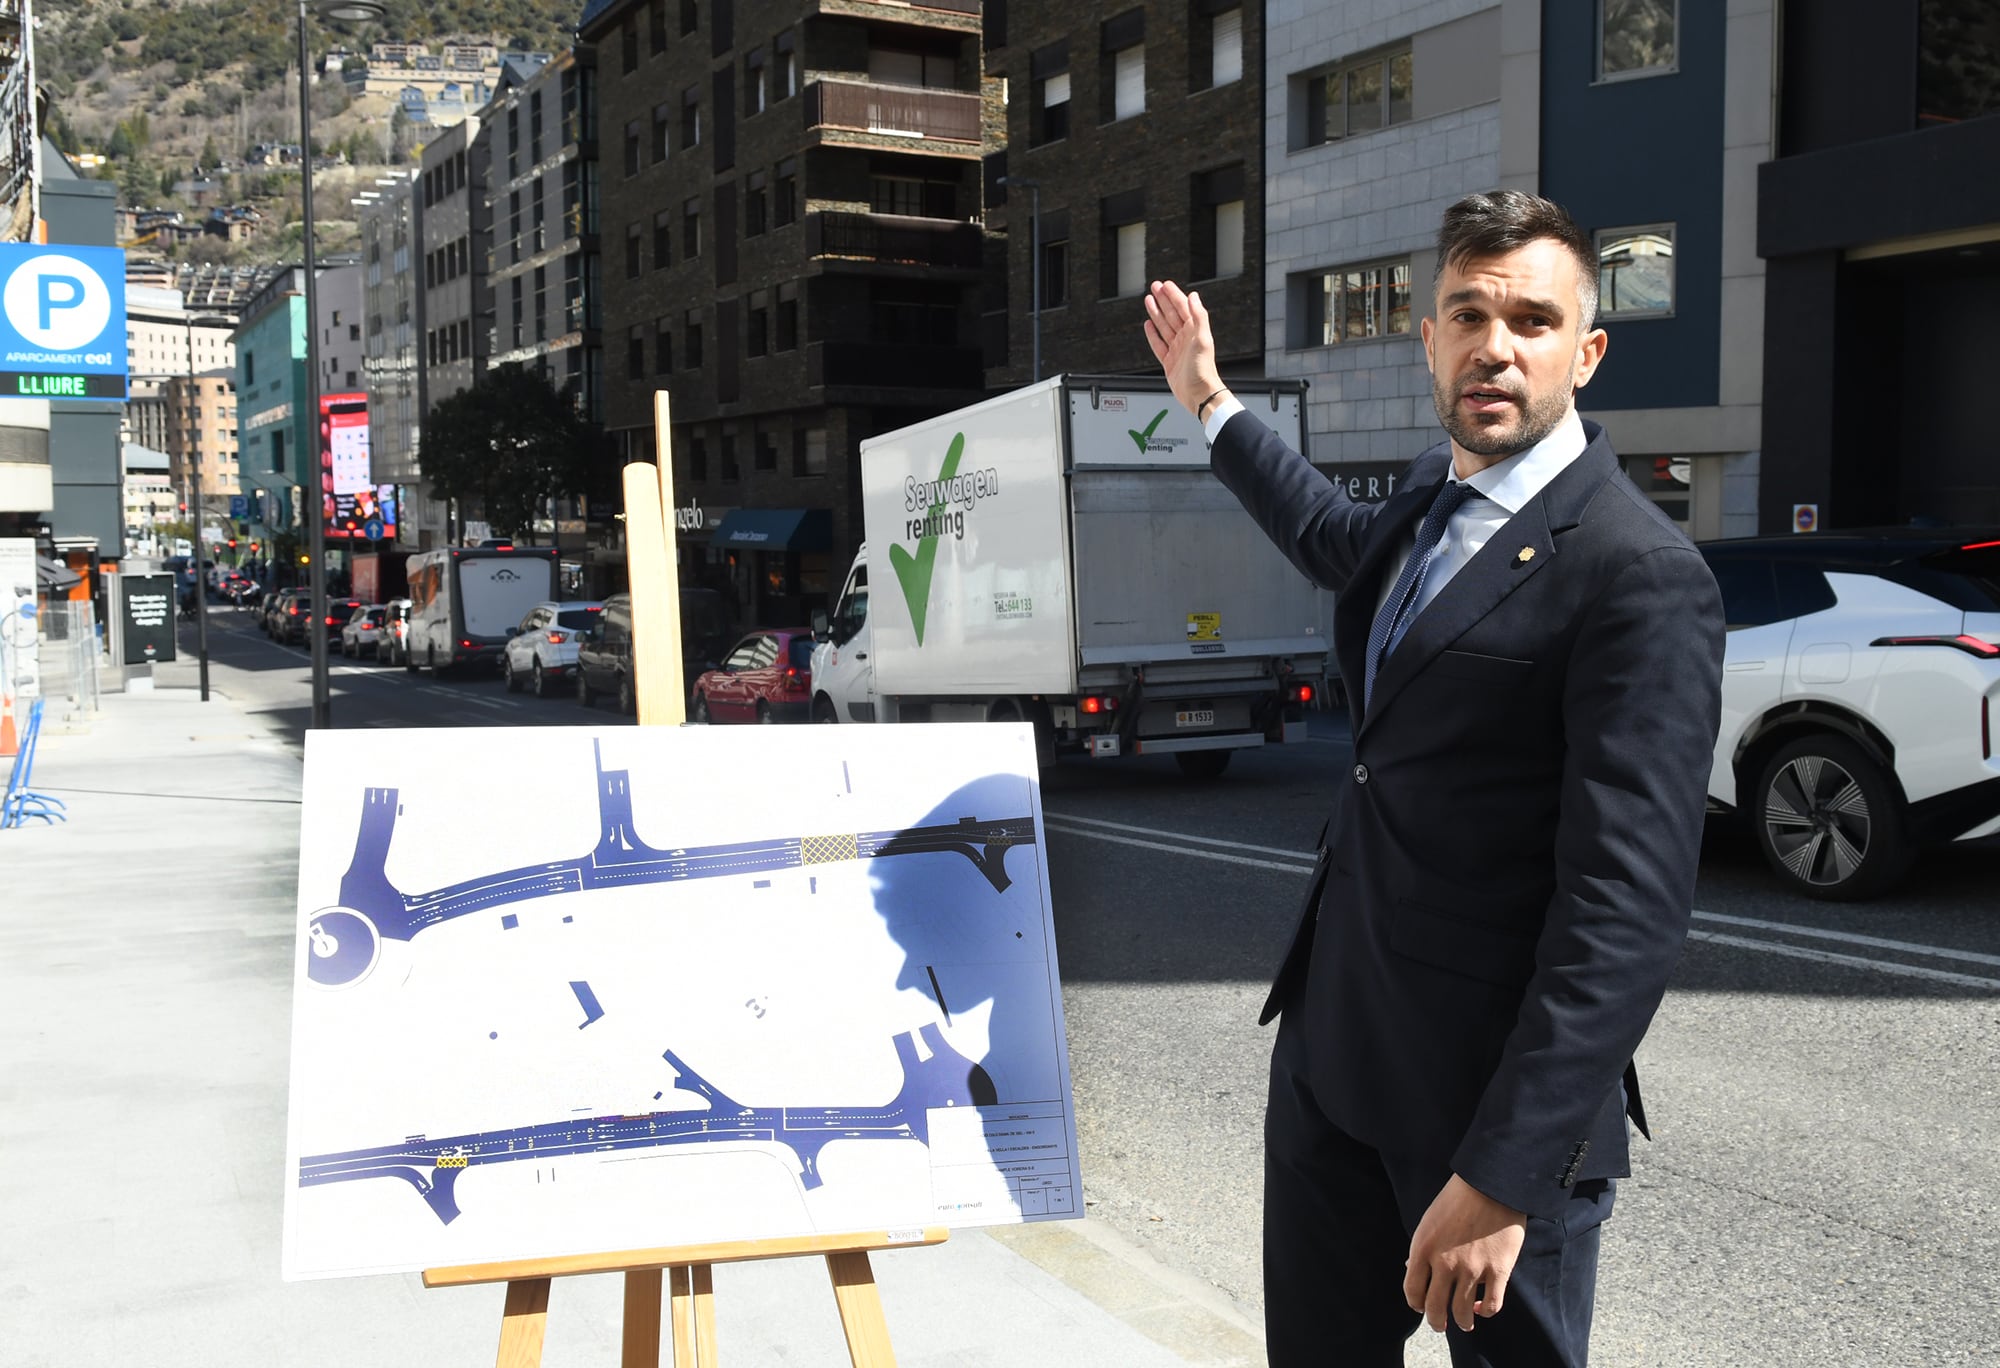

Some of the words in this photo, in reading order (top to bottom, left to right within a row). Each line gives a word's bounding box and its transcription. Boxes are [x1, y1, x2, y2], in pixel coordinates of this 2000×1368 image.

[38, 274, 86, 330] P
[5, 351, 83, 364] APARCAMENT
[18, 375, 86, 395] LLIURE
[904, 467, 999, 512] Seuwagen
[906, 508, 964, 541] renting
[1008, 599, 1019, 612] 644
[1020, 597, 1032, 611] 133
[1194, 711, 1212, 722] 1533
